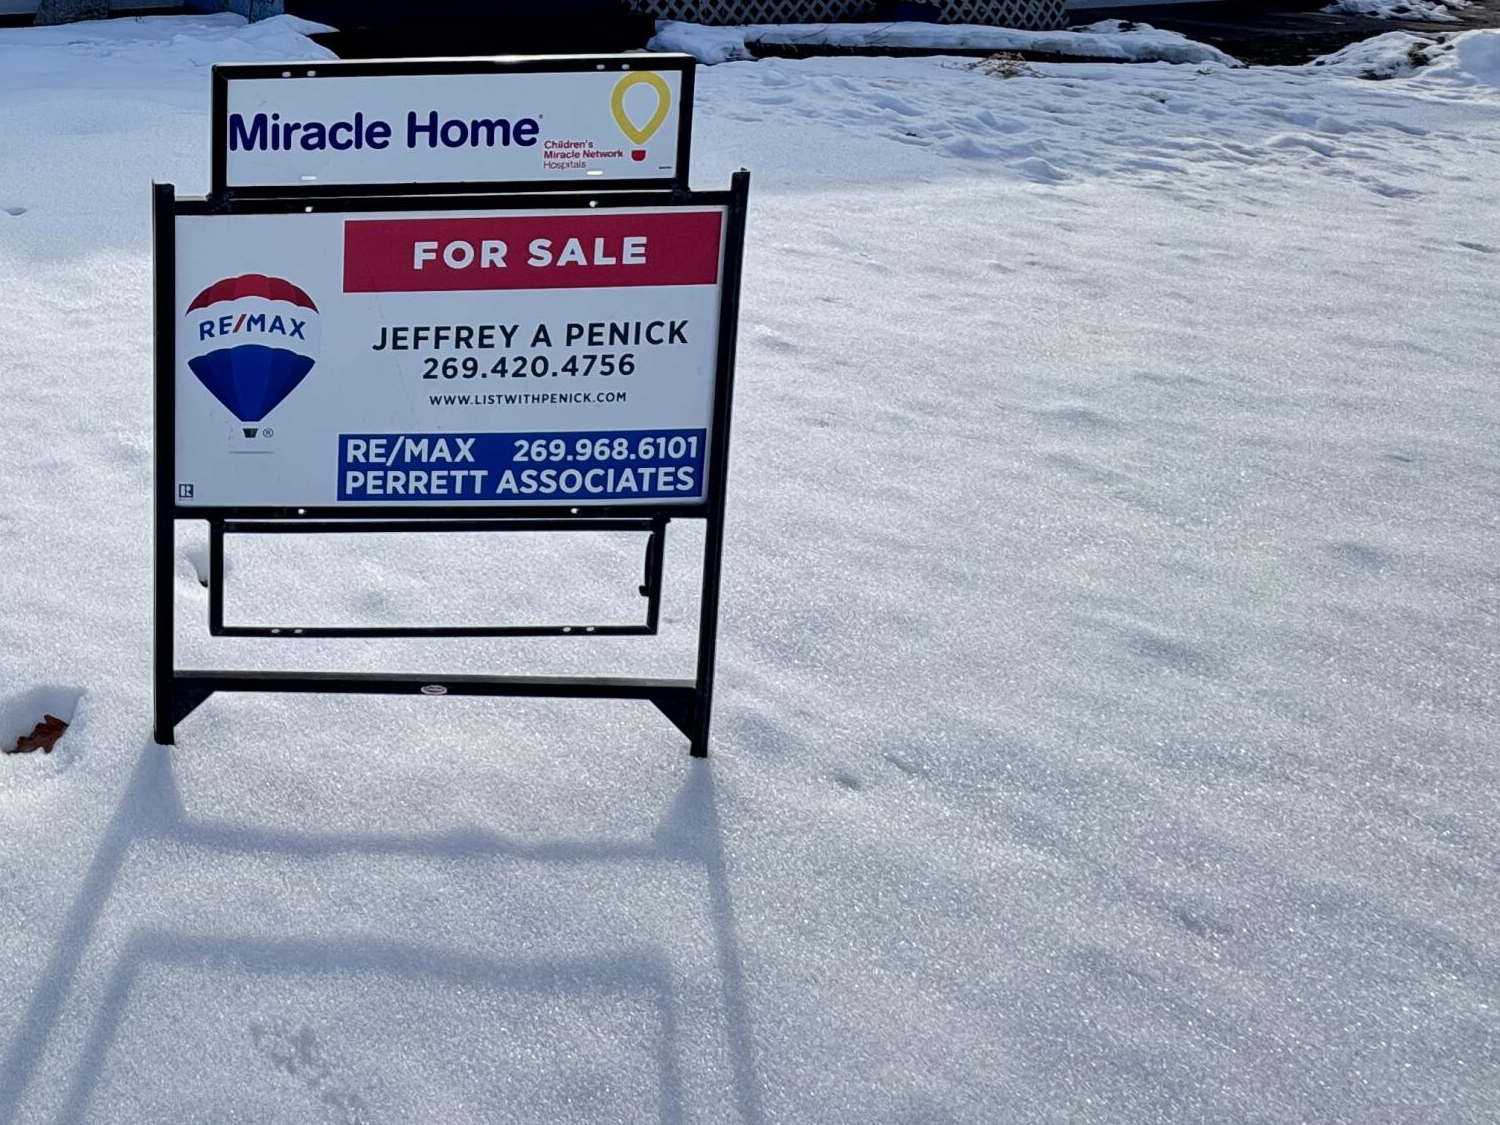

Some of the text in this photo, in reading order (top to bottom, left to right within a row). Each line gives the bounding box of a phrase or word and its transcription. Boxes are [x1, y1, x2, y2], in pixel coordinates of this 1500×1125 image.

[229, 110, 540, 152] Miracle Home
[544, 140, 594, 149] Children's
[543, 149, 624, 159] Miracle Network
[543, 160, 587, 170] Hospitals
[413, 236, 648, 270] FOR SALE
[199, 313, 306, 341] RE/MAX
[372, 320, 689, 351] JEFFREY A PENICK
[422, 353, 636, 380] 269.420.4756
[429, 392, 627, 406] WWW.LISTWITHPENICK.COM
[346, 436, 698, 466] RE/MAX 269.968.6101
[345, 466, 695, 495] PERRETT ASSOCIATES
